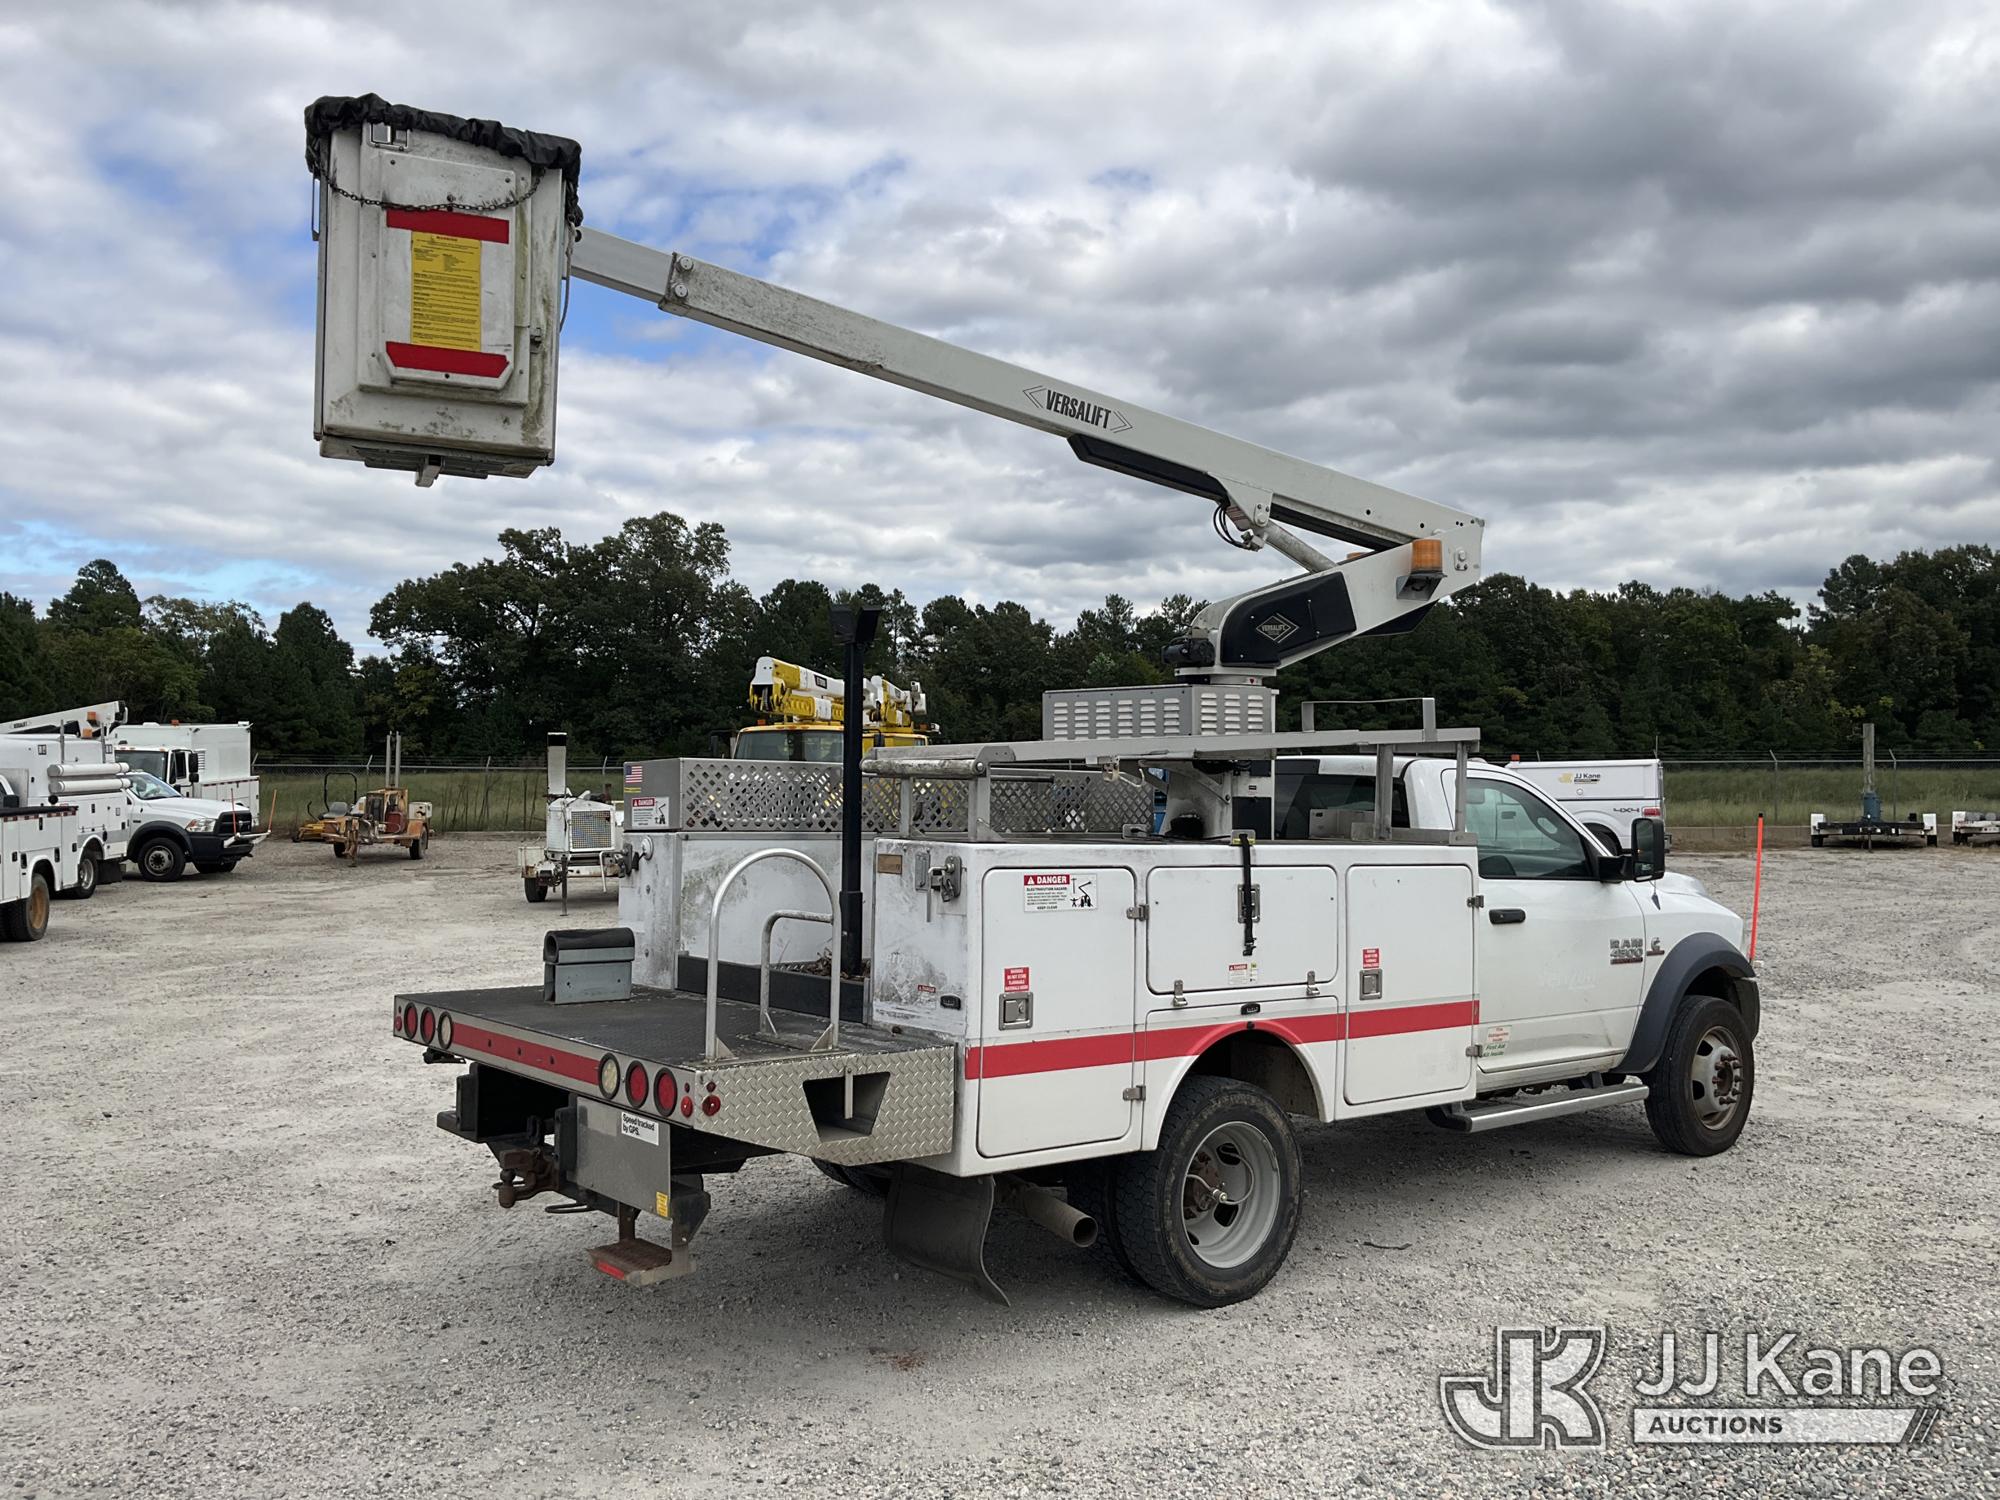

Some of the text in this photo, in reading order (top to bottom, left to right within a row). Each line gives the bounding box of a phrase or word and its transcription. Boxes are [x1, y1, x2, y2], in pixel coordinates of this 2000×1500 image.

[1046, 389, 1112, 429] VERSALIFT
[1036, 875, 1067, 885] DANGER
[1610, 938, 1643, 949] RAM
[622, 1113, 655, 1131] Speed tracked
[622, 1125, 630, 1134] by
